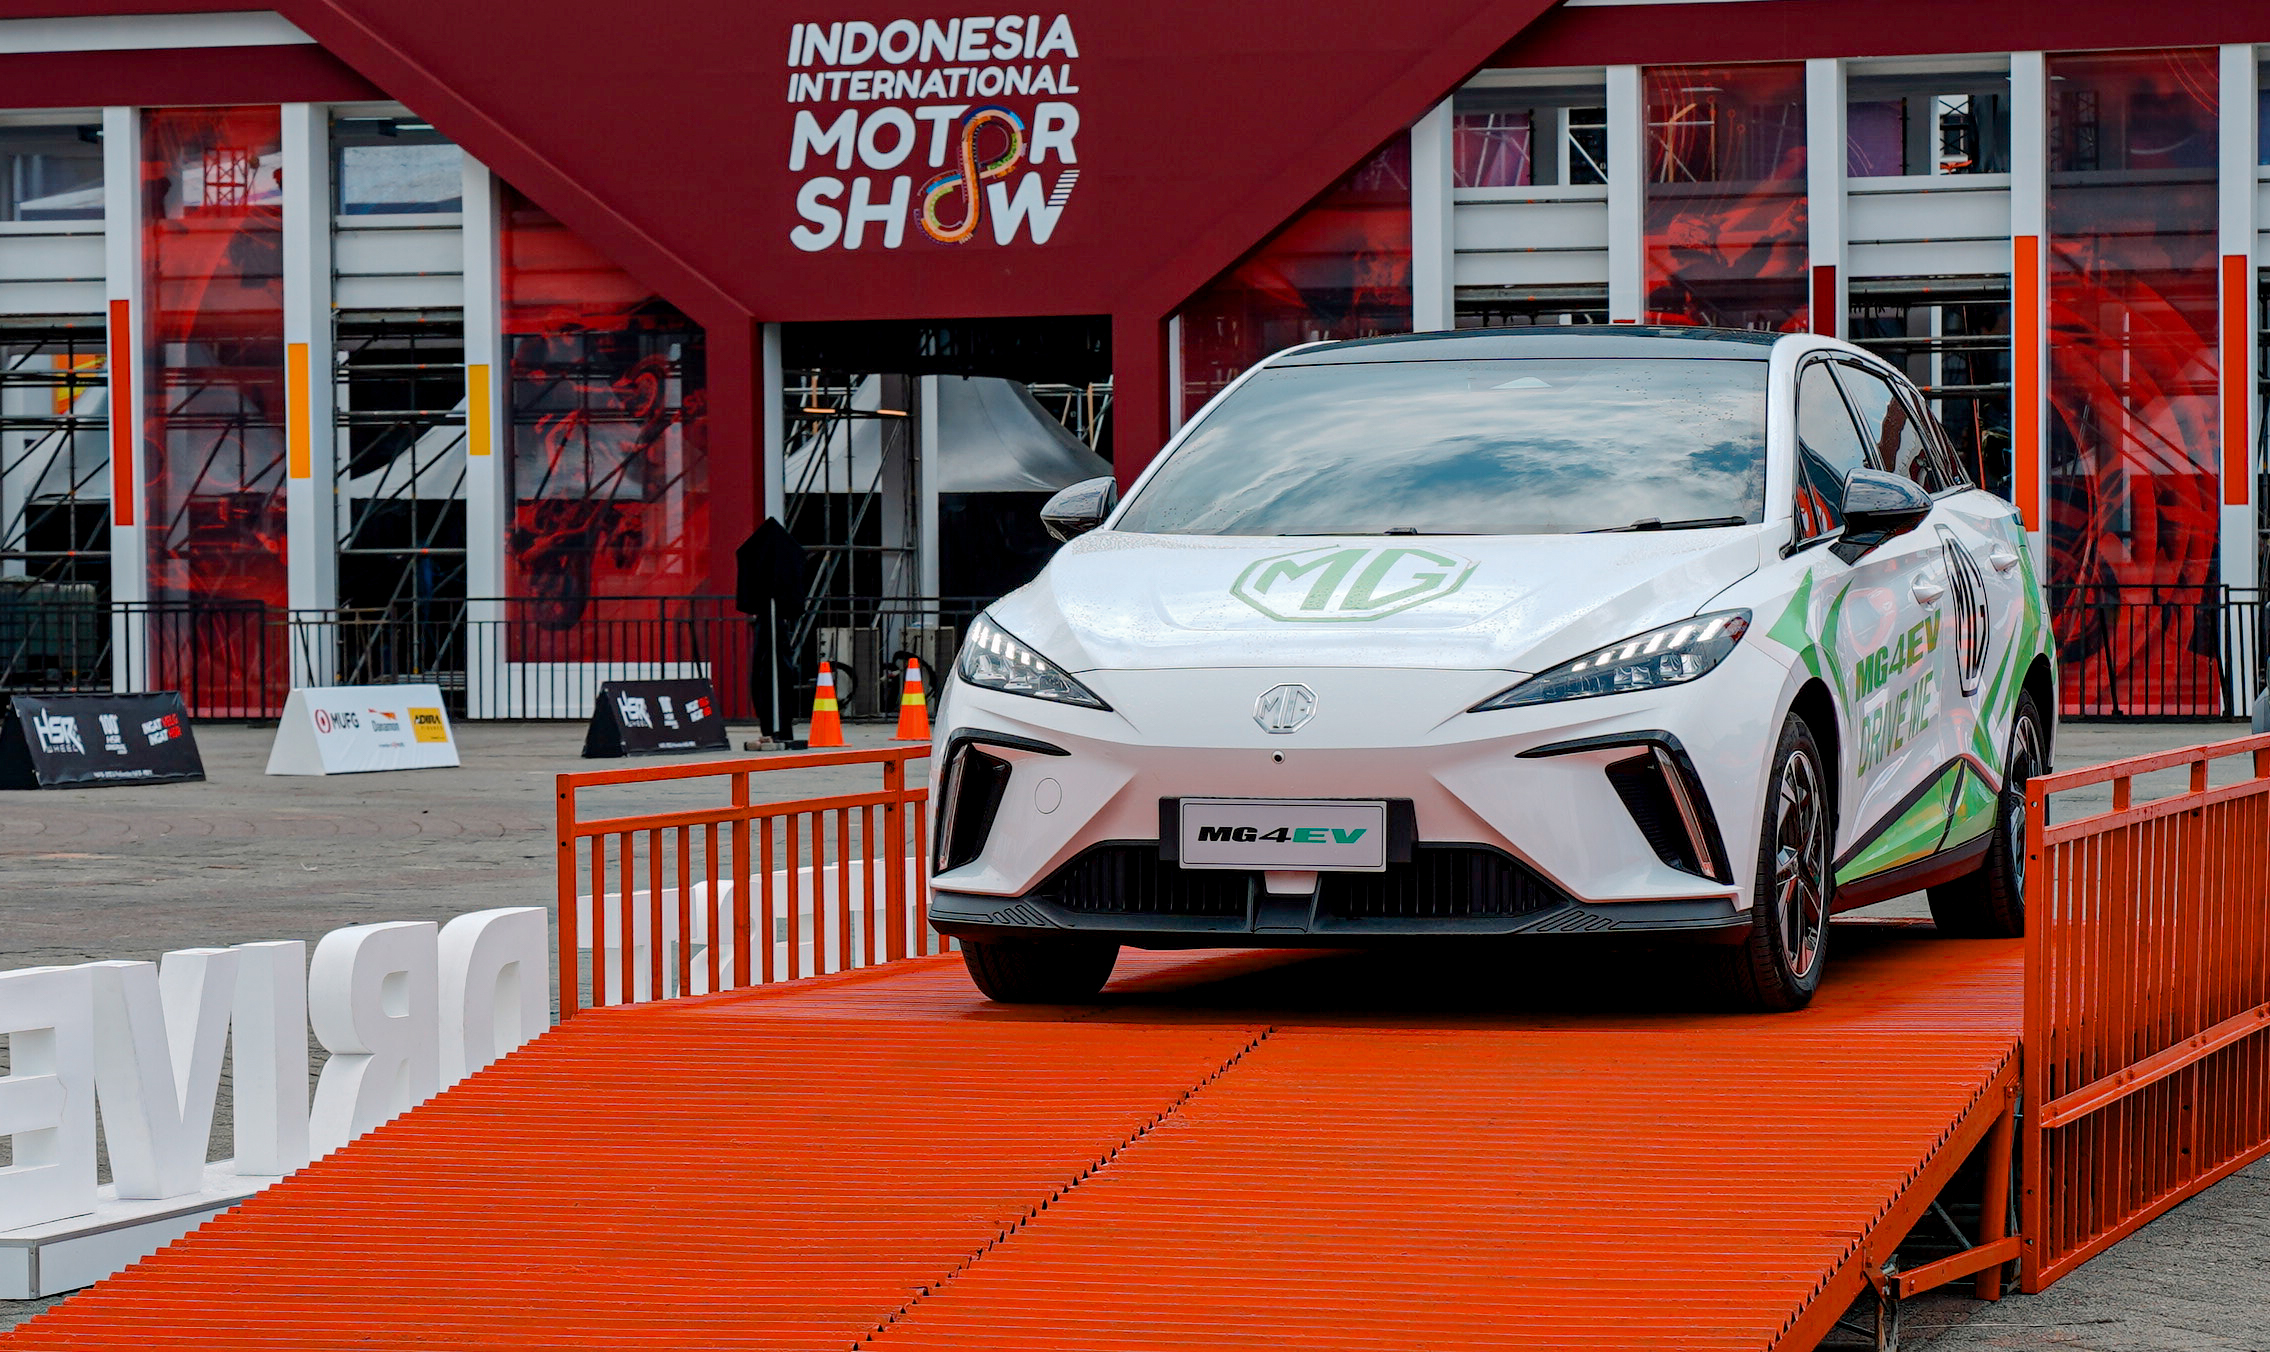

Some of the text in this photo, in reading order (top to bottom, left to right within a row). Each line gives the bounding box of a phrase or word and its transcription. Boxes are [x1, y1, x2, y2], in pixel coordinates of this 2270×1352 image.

[787, 13, 1079, 67] INDONESIA
[787, 63, 1079, 103] INTERNATIONAL
[788, 101, 1080, 172] MOTOR
[789, 169, 1080, 252] SHOW
[1253, 548, 1458, 611] MG
[1945, 538, 1987, 680] MG
[1855, 608, 1941, 703] MG4EV
[330, 712, 360, 729] MUFG
[371, 720, 400, 732] Danamon
[1257, 685, 1315, 731] MG
[1857, 670, 1934, 778] DRIVE ME
[1197, 826, 1368, 844] MG4EV
